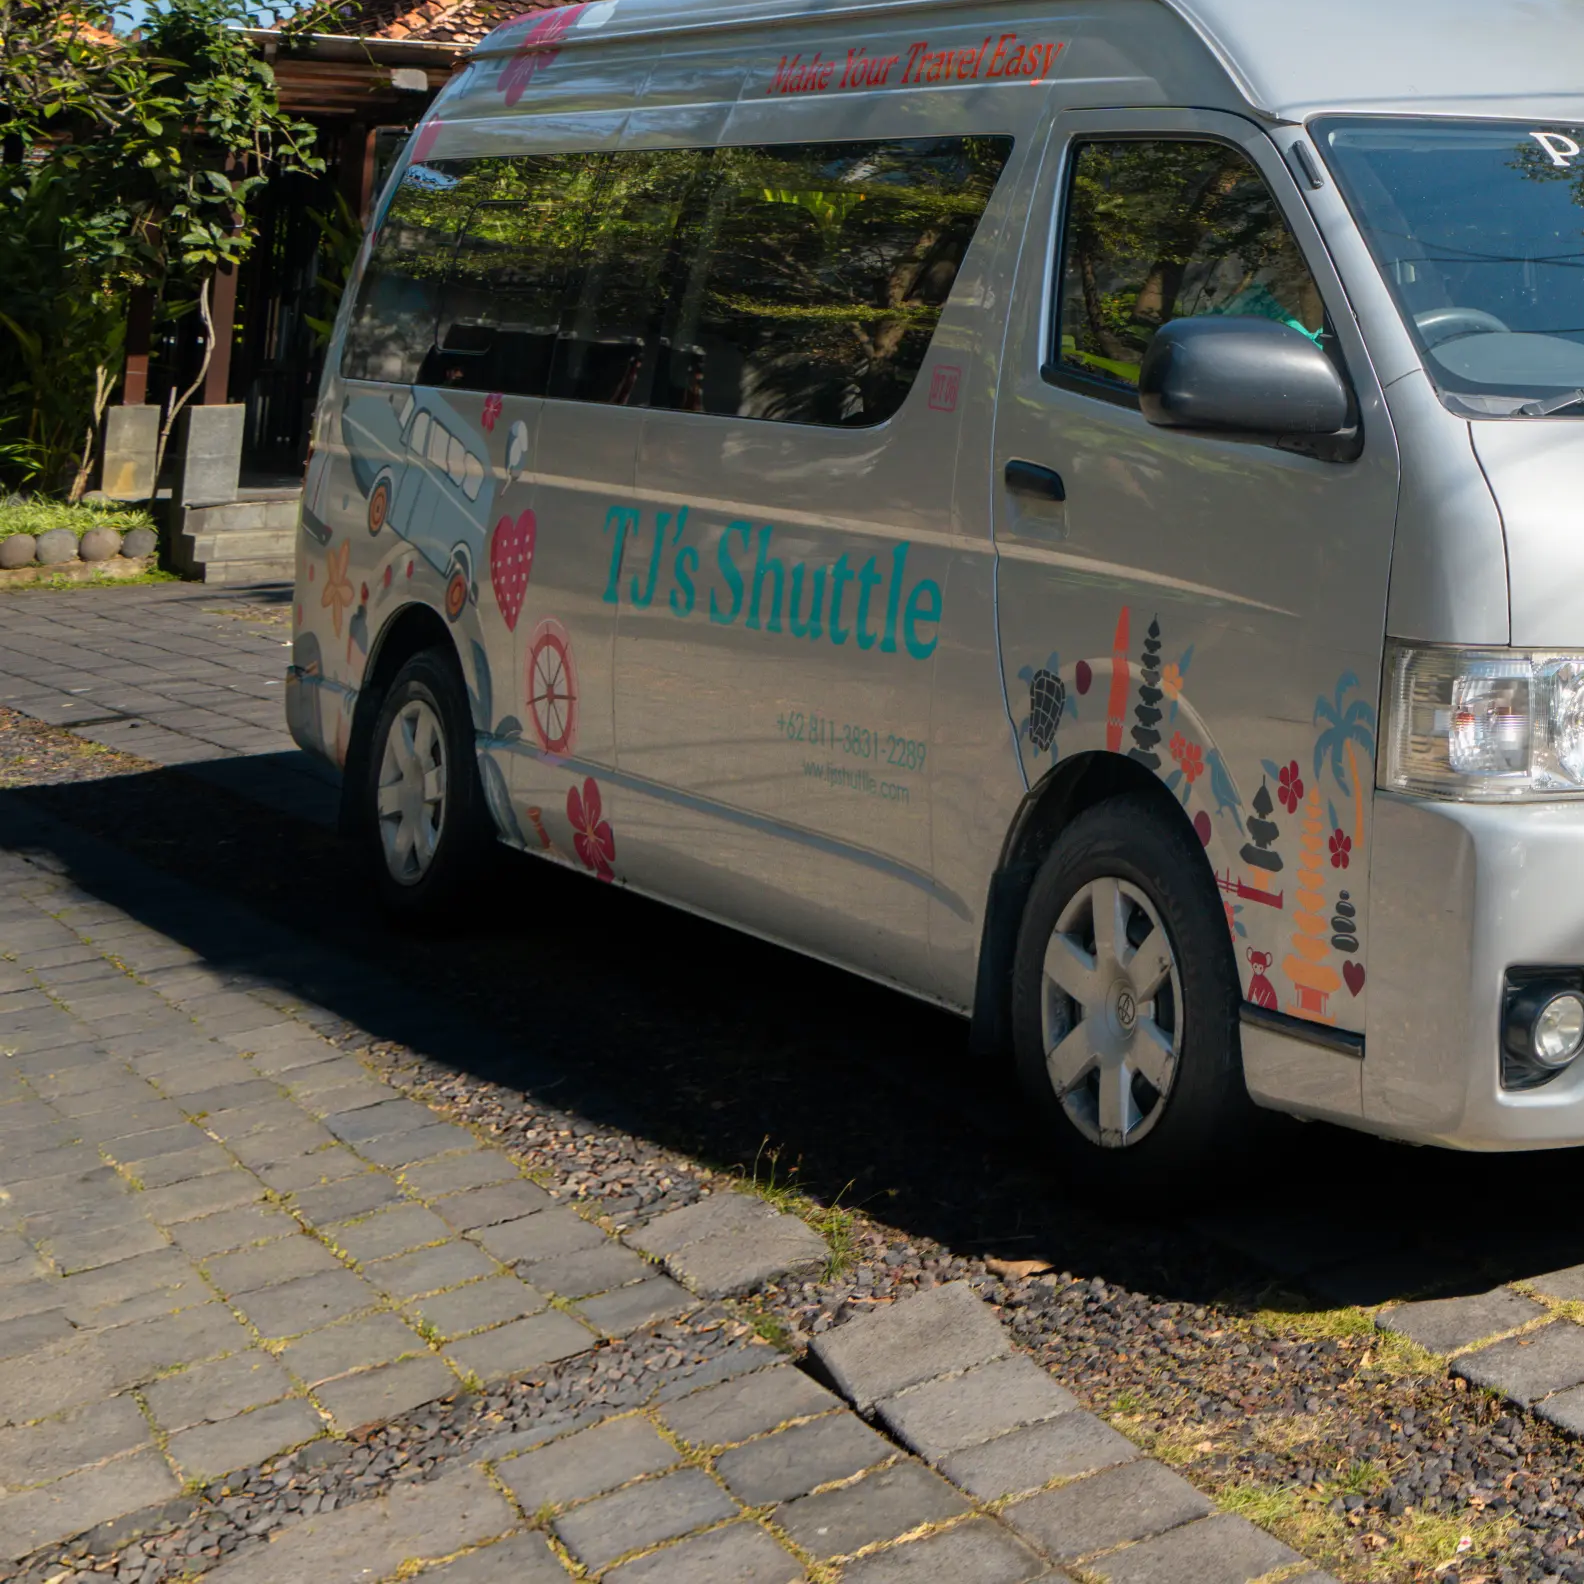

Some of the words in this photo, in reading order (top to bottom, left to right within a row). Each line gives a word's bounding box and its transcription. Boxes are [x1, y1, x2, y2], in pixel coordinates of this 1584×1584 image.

[766, 52, 832, 95] Make
[839, 47, 899, 89] Your
[901, 41, 991, 85] Travel
[987, 33, 1065, 87] Easy
[602, 504, 700, 618] TJ's
[709, 520, 943, 660] Shuttle
[777, 711, 804, 741] +62
[808, 713, 927, 772] 811-3831-2289
